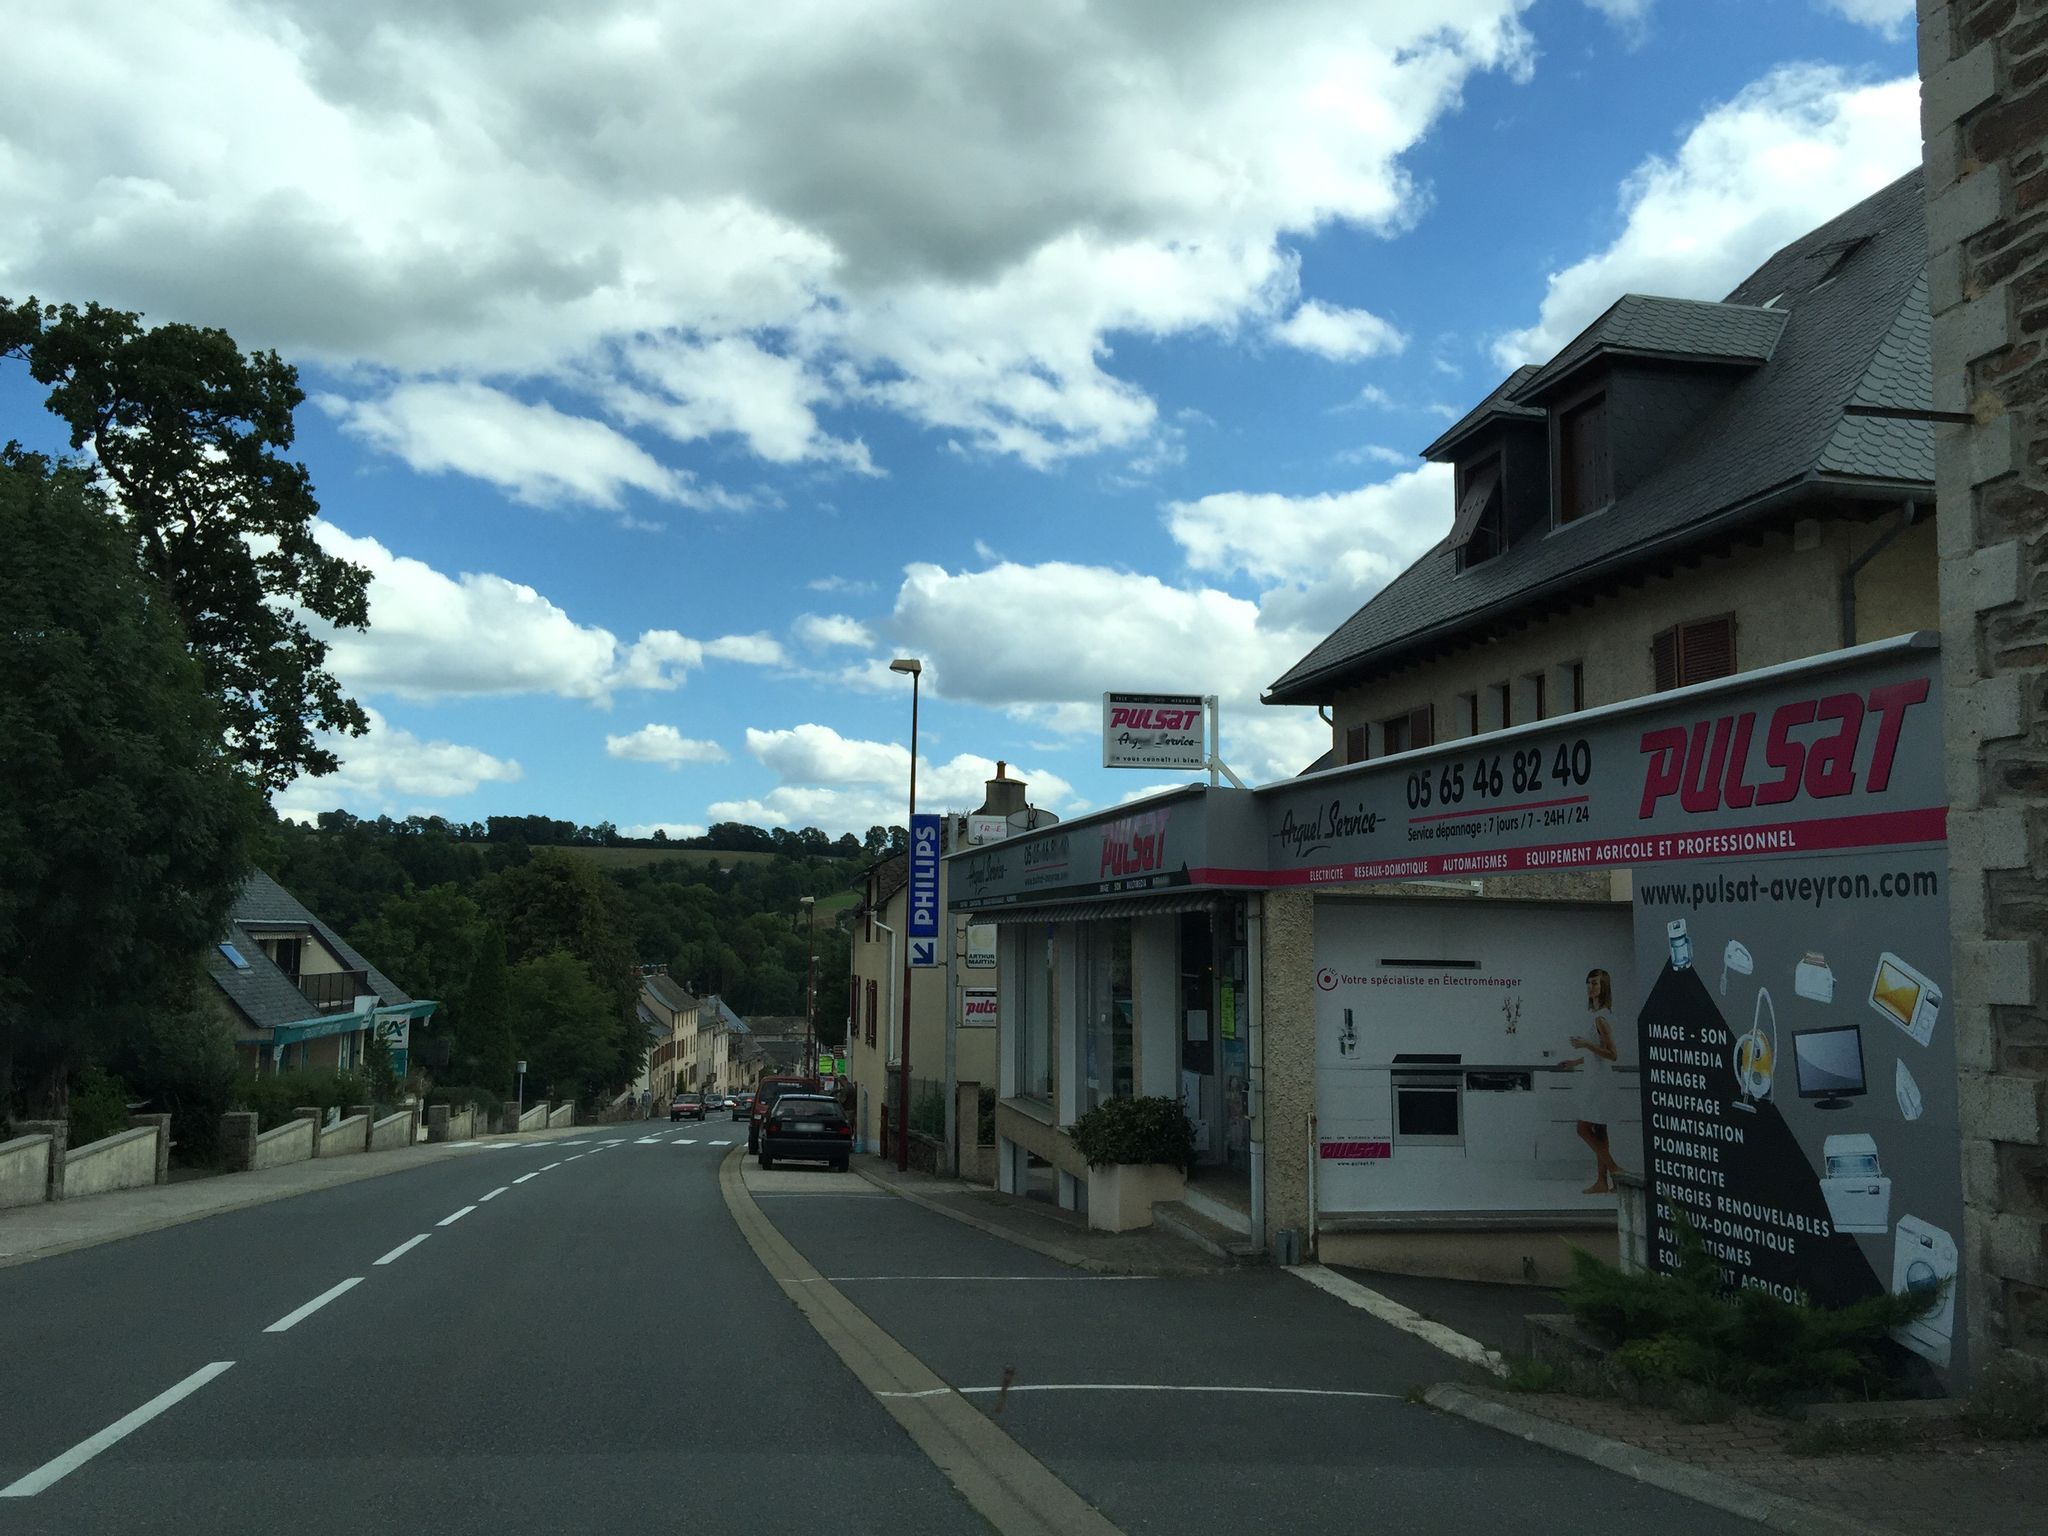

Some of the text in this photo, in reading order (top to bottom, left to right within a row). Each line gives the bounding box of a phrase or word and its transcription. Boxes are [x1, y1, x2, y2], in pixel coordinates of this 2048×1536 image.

[1406, 739, 1591, 810] 05 65 46 82 40
[1324, 800, 1377, 839] Service
[1408, 827, 1433, 842] Service
[1436, 821, 1481, 841] dépannage
[1488, 817, 1494, 832] 7
[1496, 815, 1519, 836] jours
[1528, 812, 1534, 829] 7
[1544, 809, 1564, 827] 24H
[1576, 806, 1590, 823] 24
[1310, 830, 1796, 881] ELECTRICITE RESEAUX-DOMOTIQUE AUTOMATISMES EQUIPEMENT AGRICOLE ET PROFESSIONNEL
[914, 826, 936, 926] PHILIPS
[1641, 870, 1938, 911] www.pulsat-aveyron.com
[1341, 973, 1521, 988] Votre spécialiste en Électroménager
[1648, 1024, 1685, 1040] IMAGE
[1701, 1028, 1727, 1045] SON
[1649, 1046, 1723, 1069] MULTIMEDIA
[1650, 1068, 1706, 1090] MENAGER
[1651, 1090, 1720, 1115] CHAUFFAGE
[1652, 1113, 1744, 1144] CLIMATISATION
[1654, 1135, 1719, 1163] PLOMBERIE
[1655, 1158, 1725, 1188] ELECTRICITE
[1655, 1181, 1830, 1238] ENERGIES RENOUVELABLES
[1657, 1203, 1795, 1255] RESAUX-DOMOTIQUE
